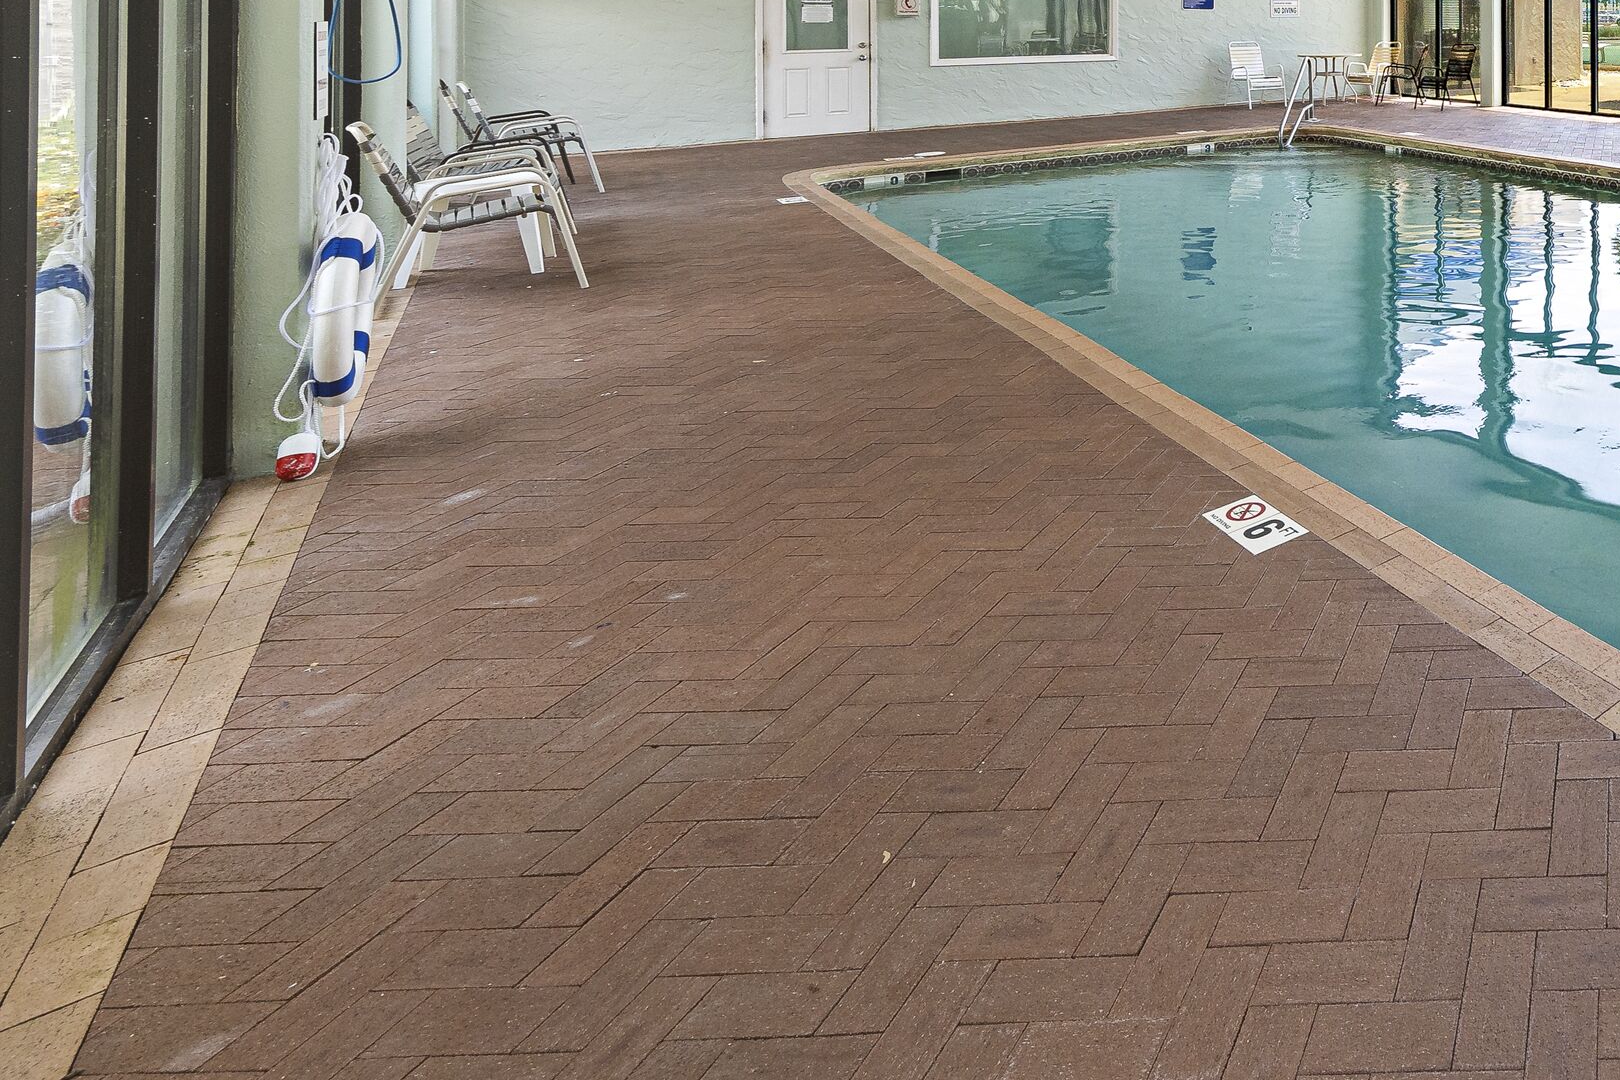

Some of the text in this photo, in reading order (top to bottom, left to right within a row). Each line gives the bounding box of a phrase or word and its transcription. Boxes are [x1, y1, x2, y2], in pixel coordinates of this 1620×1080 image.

[1216, 517, 1231, 530] DIVING
[1243, 519, 1300, 539] 6 FT
